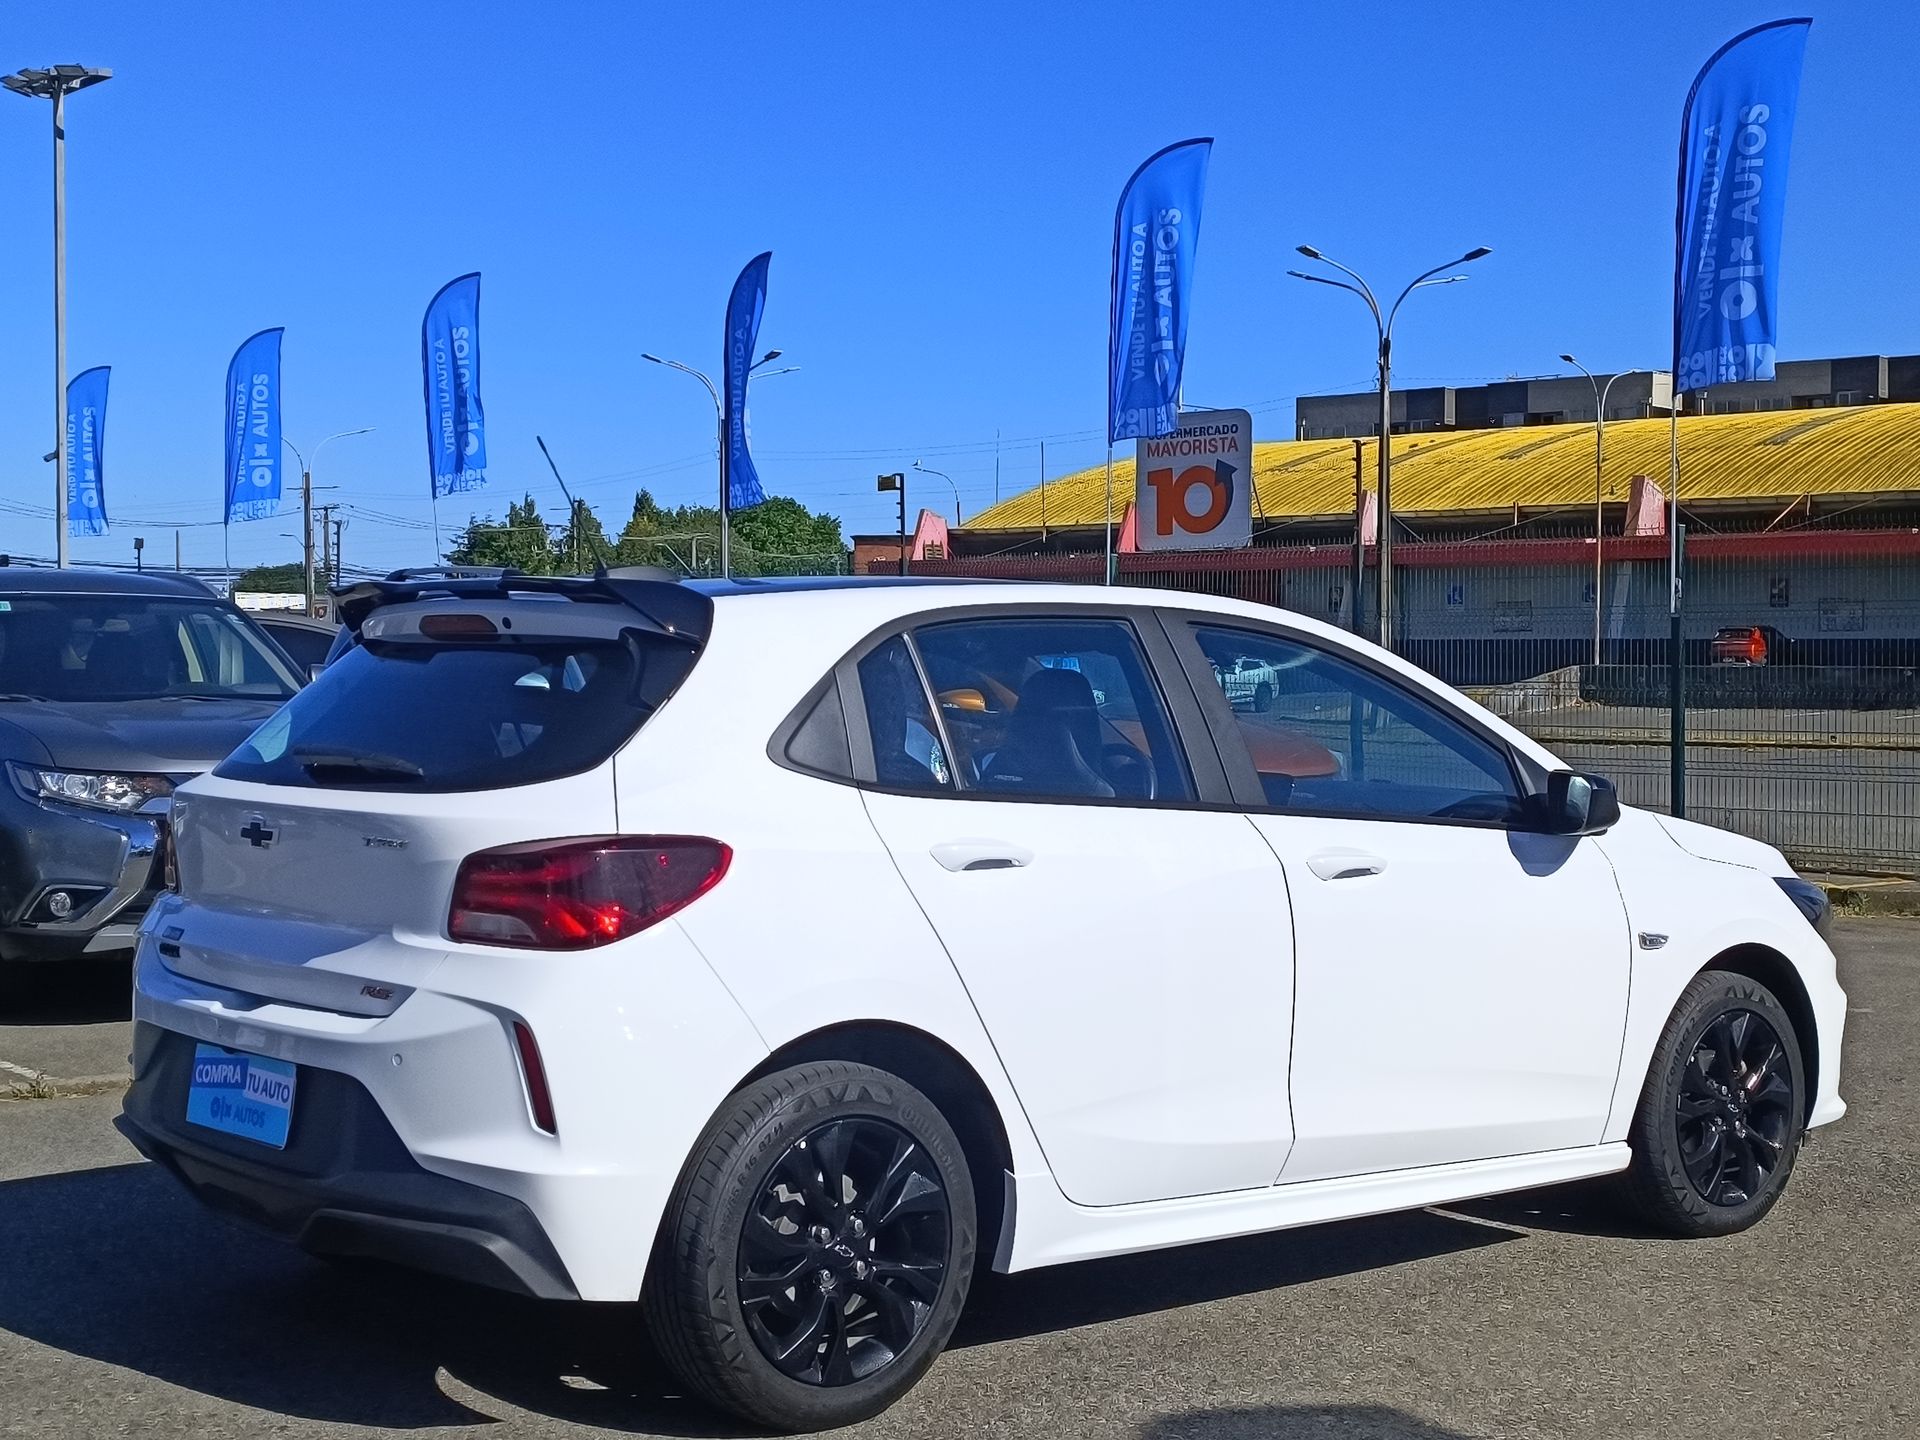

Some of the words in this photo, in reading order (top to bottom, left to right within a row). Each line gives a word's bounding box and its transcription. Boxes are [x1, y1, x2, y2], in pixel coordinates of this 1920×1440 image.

[1732, 103, 1770, 225] AUTOS
[1132, 222, 1148, 238] A
[1153, 207, 1183, 309] AUTOS
[434, 338, 446, 350] A
[734, 328, 745, 340] A
[1131, 323, 1146, 382] VENDE
[435, 352, 449, 390] AUTO
[733, 344, 745, 387] AUTO
[252, 373, 270, 438] AUTOS
[439, 392, 451, 409] TU
[67, 423, 77, 455] AUTO
[442, 410, 457, 456] VENDE
[732, 411, 743, 461] VENDE
[1147, 436, 1239, 459] MAYORISTA
[1147, 464, 1233, 536] 10
[195, 1063, 241, 1085] COMPRA
[248, 1072, 261, 1094] TU
[260, 1078, 291, 1104] AUTO
[233, 1106, 266, 1129] AUTOS
